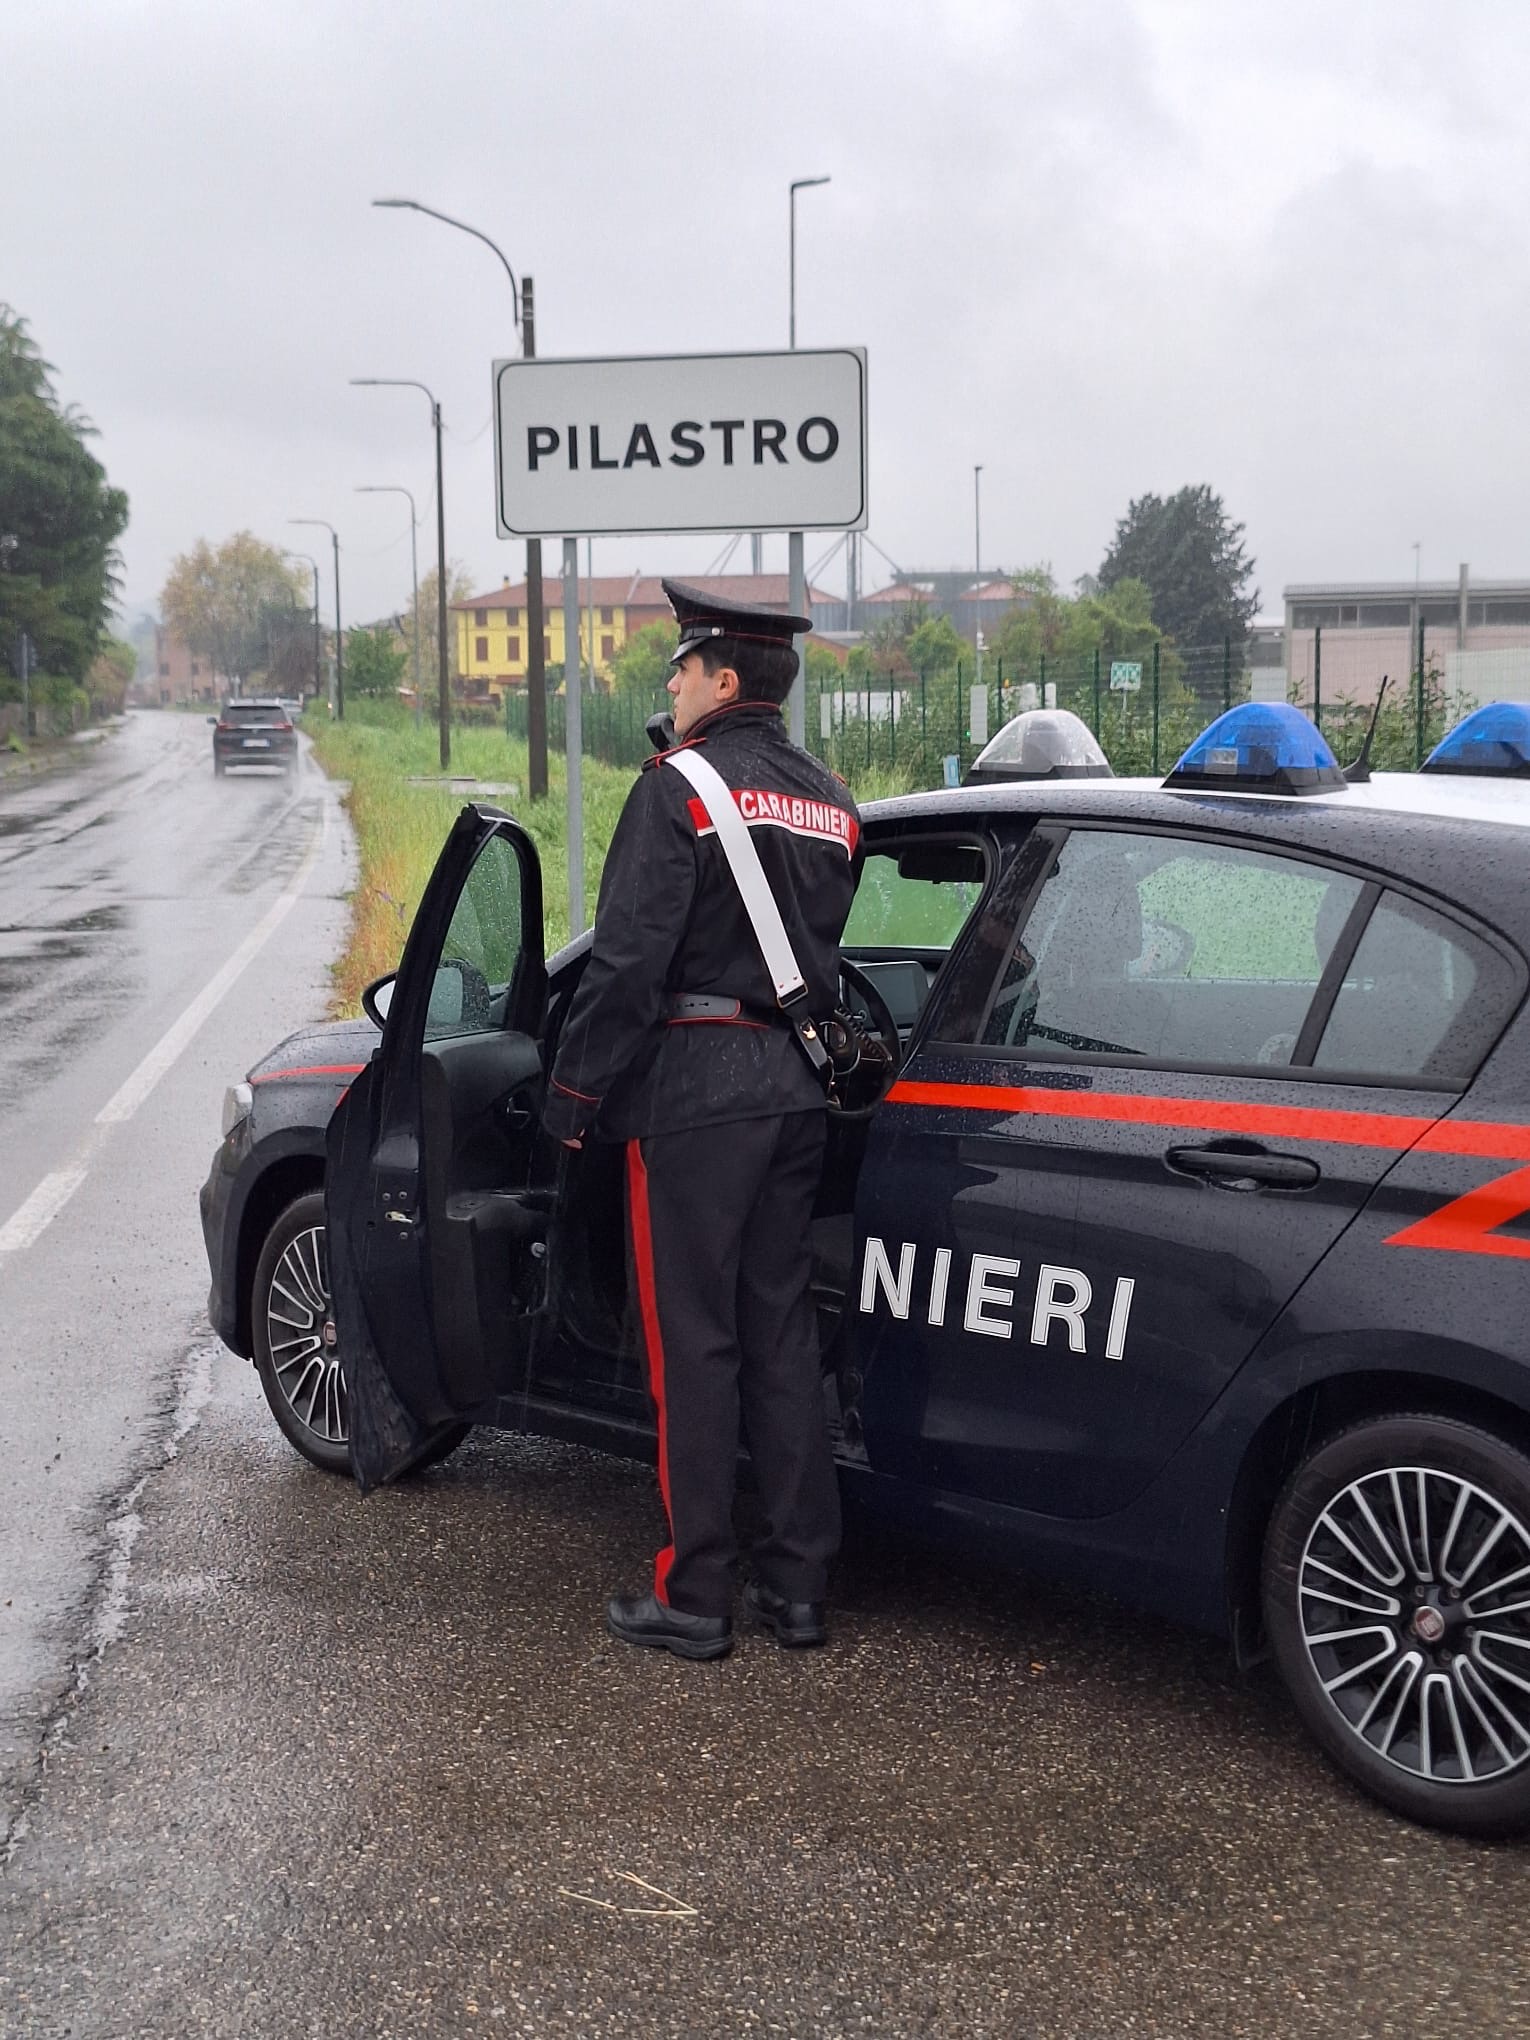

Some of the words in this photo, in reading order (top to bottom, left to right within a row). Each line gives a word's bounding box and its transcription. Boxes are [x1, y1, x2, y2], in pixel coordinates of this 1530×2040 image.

[526, 416, 840, 472] PILASTRO
[740, 791, 850, 840] CARABINIERI
[859, 1236, 1136, 1361] NIERI
